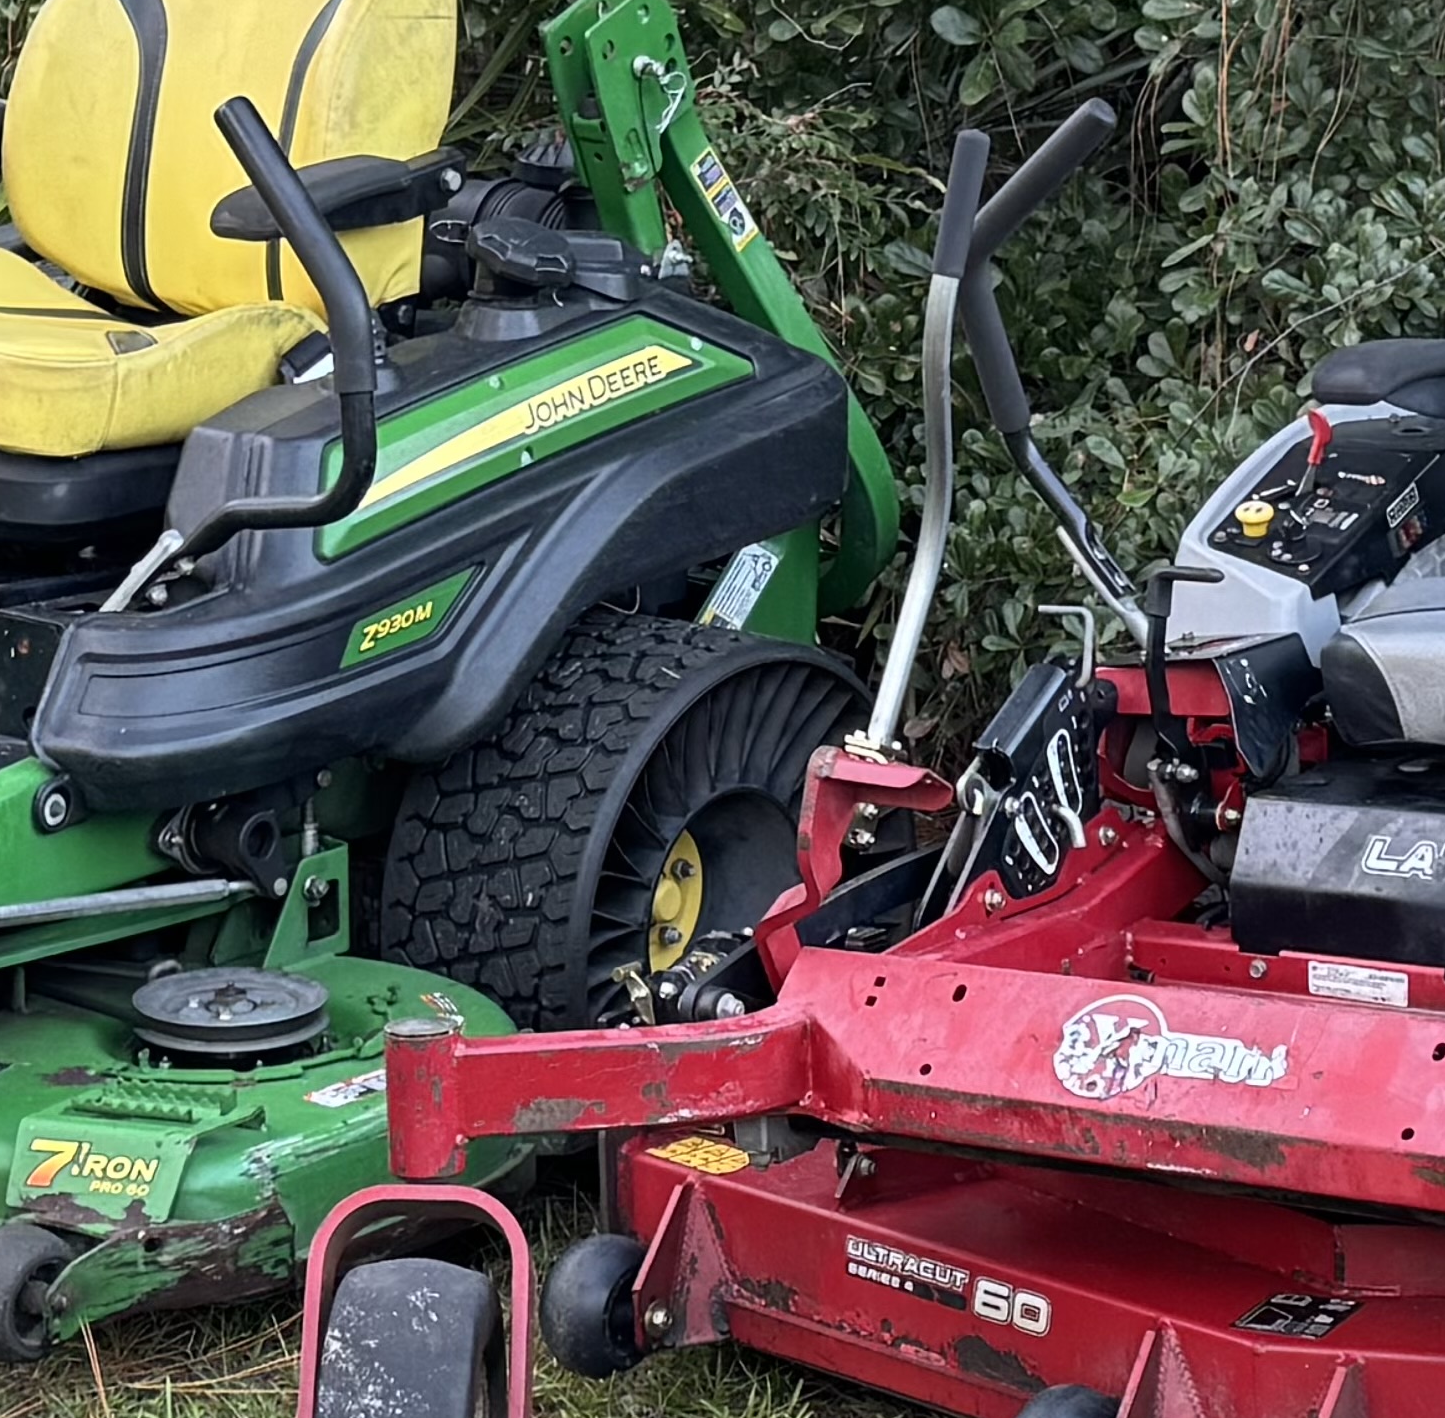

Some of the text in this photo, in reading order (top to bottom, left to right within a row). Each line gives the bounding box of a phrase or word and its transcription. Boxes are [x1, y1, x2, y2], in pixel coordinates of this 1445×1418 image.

[525, 355, 662, 430] JOHN DEERE
[359, 601, 433, 652] Z930M
[89, 1180, 150, 1198] PRO 60
[846, 1237, 969, 1291] ULTRACUT
[847, 1262, 901, 1288] SERIES
[973, 1277, 1052, 1337] 60
